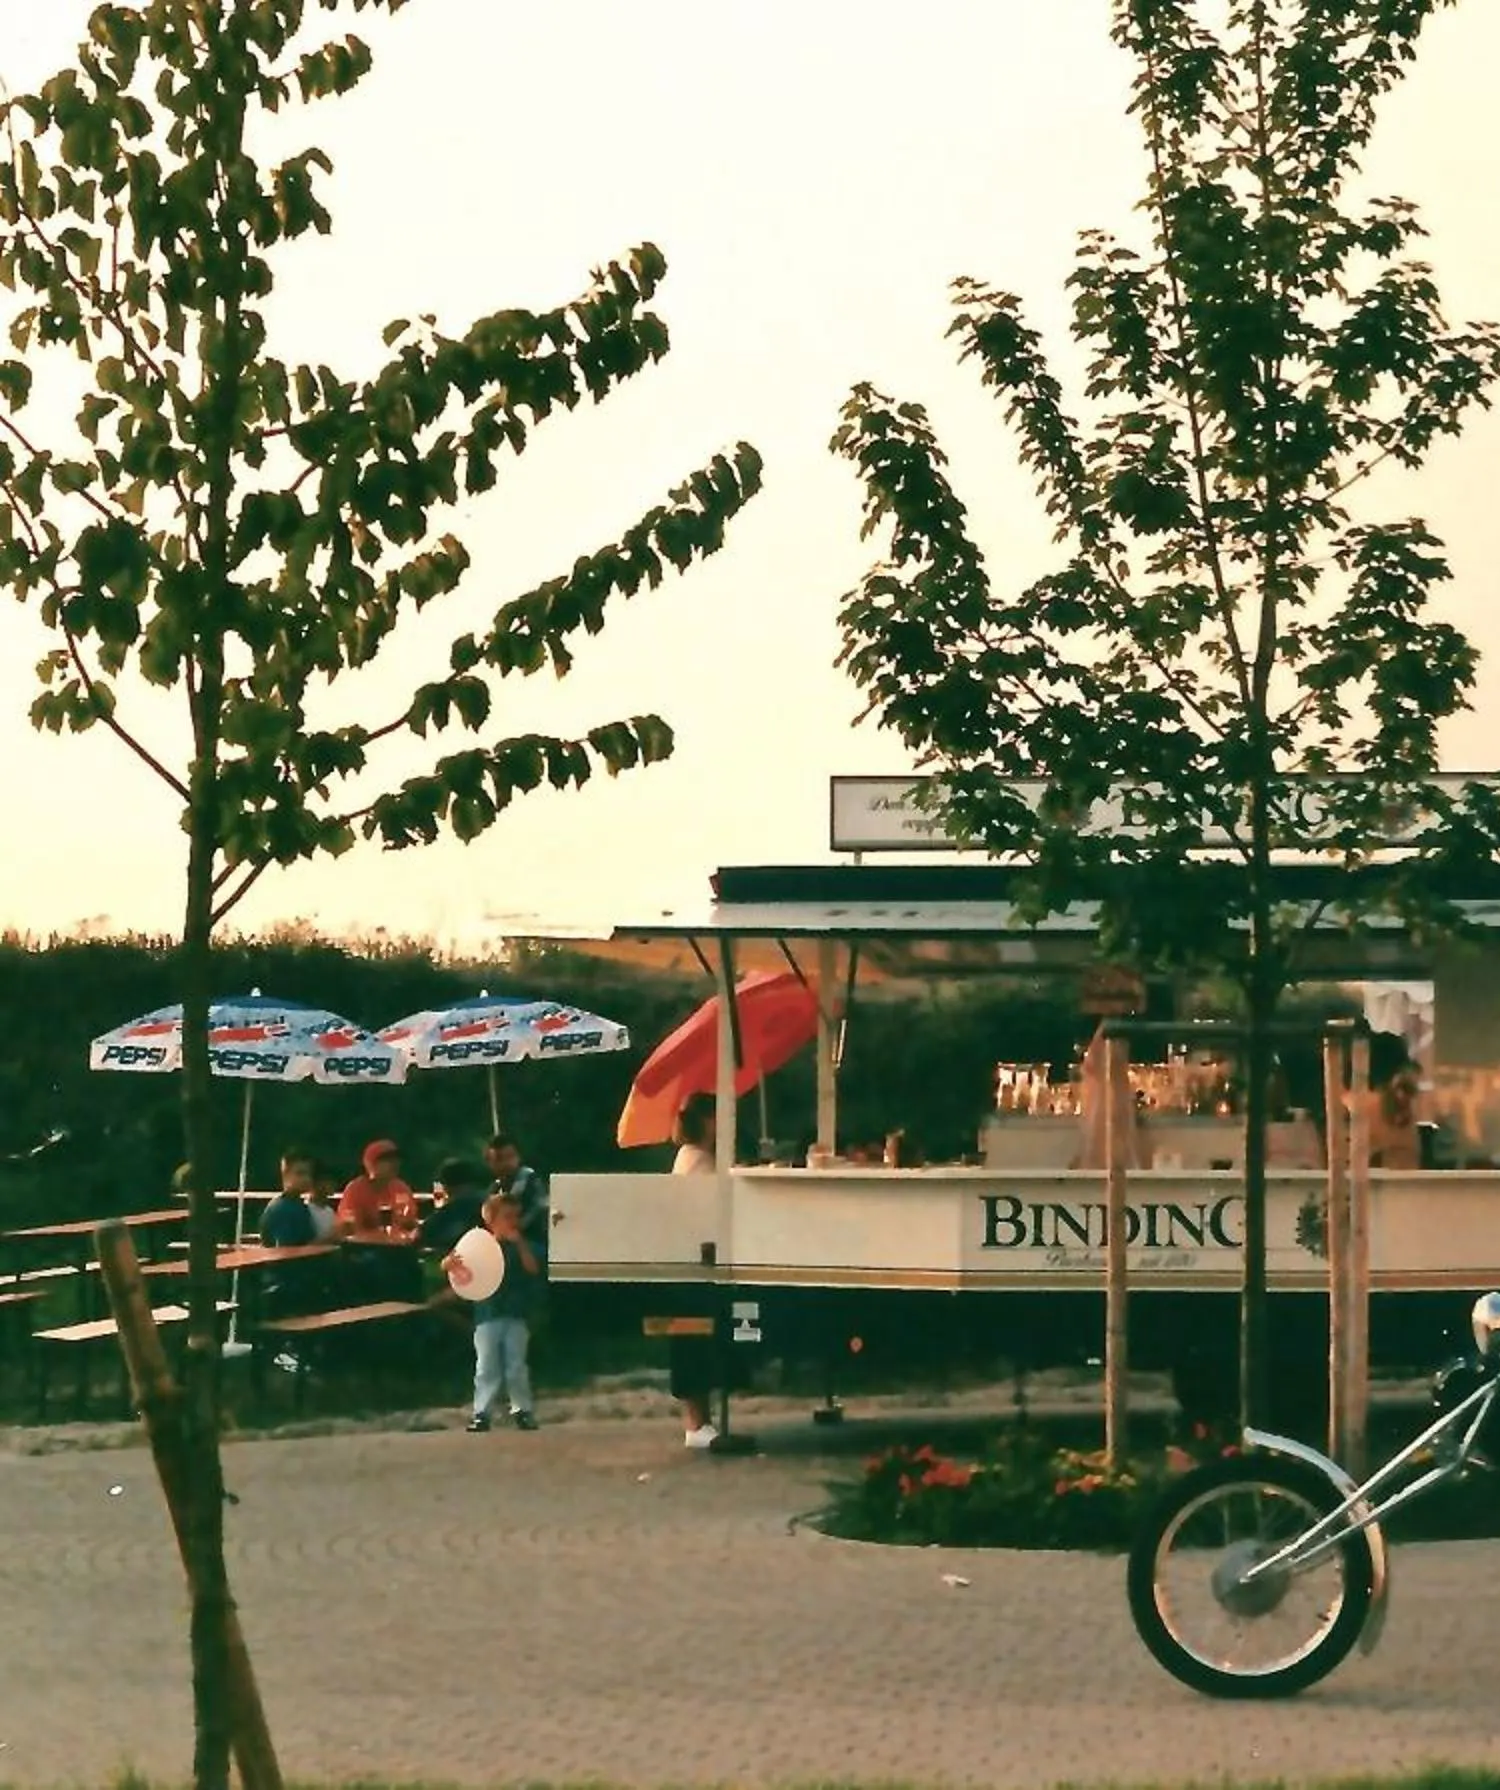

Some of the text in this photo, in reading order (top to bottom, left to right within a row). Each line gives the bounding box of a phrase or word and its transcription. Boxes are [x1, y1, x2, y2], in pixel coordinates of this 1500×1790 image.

[101, 1046, 167, 1066] PEPSI
[430, 1040, 510, 1060] PEPSI
[324, 1057, 392, 1076] PEPSI
